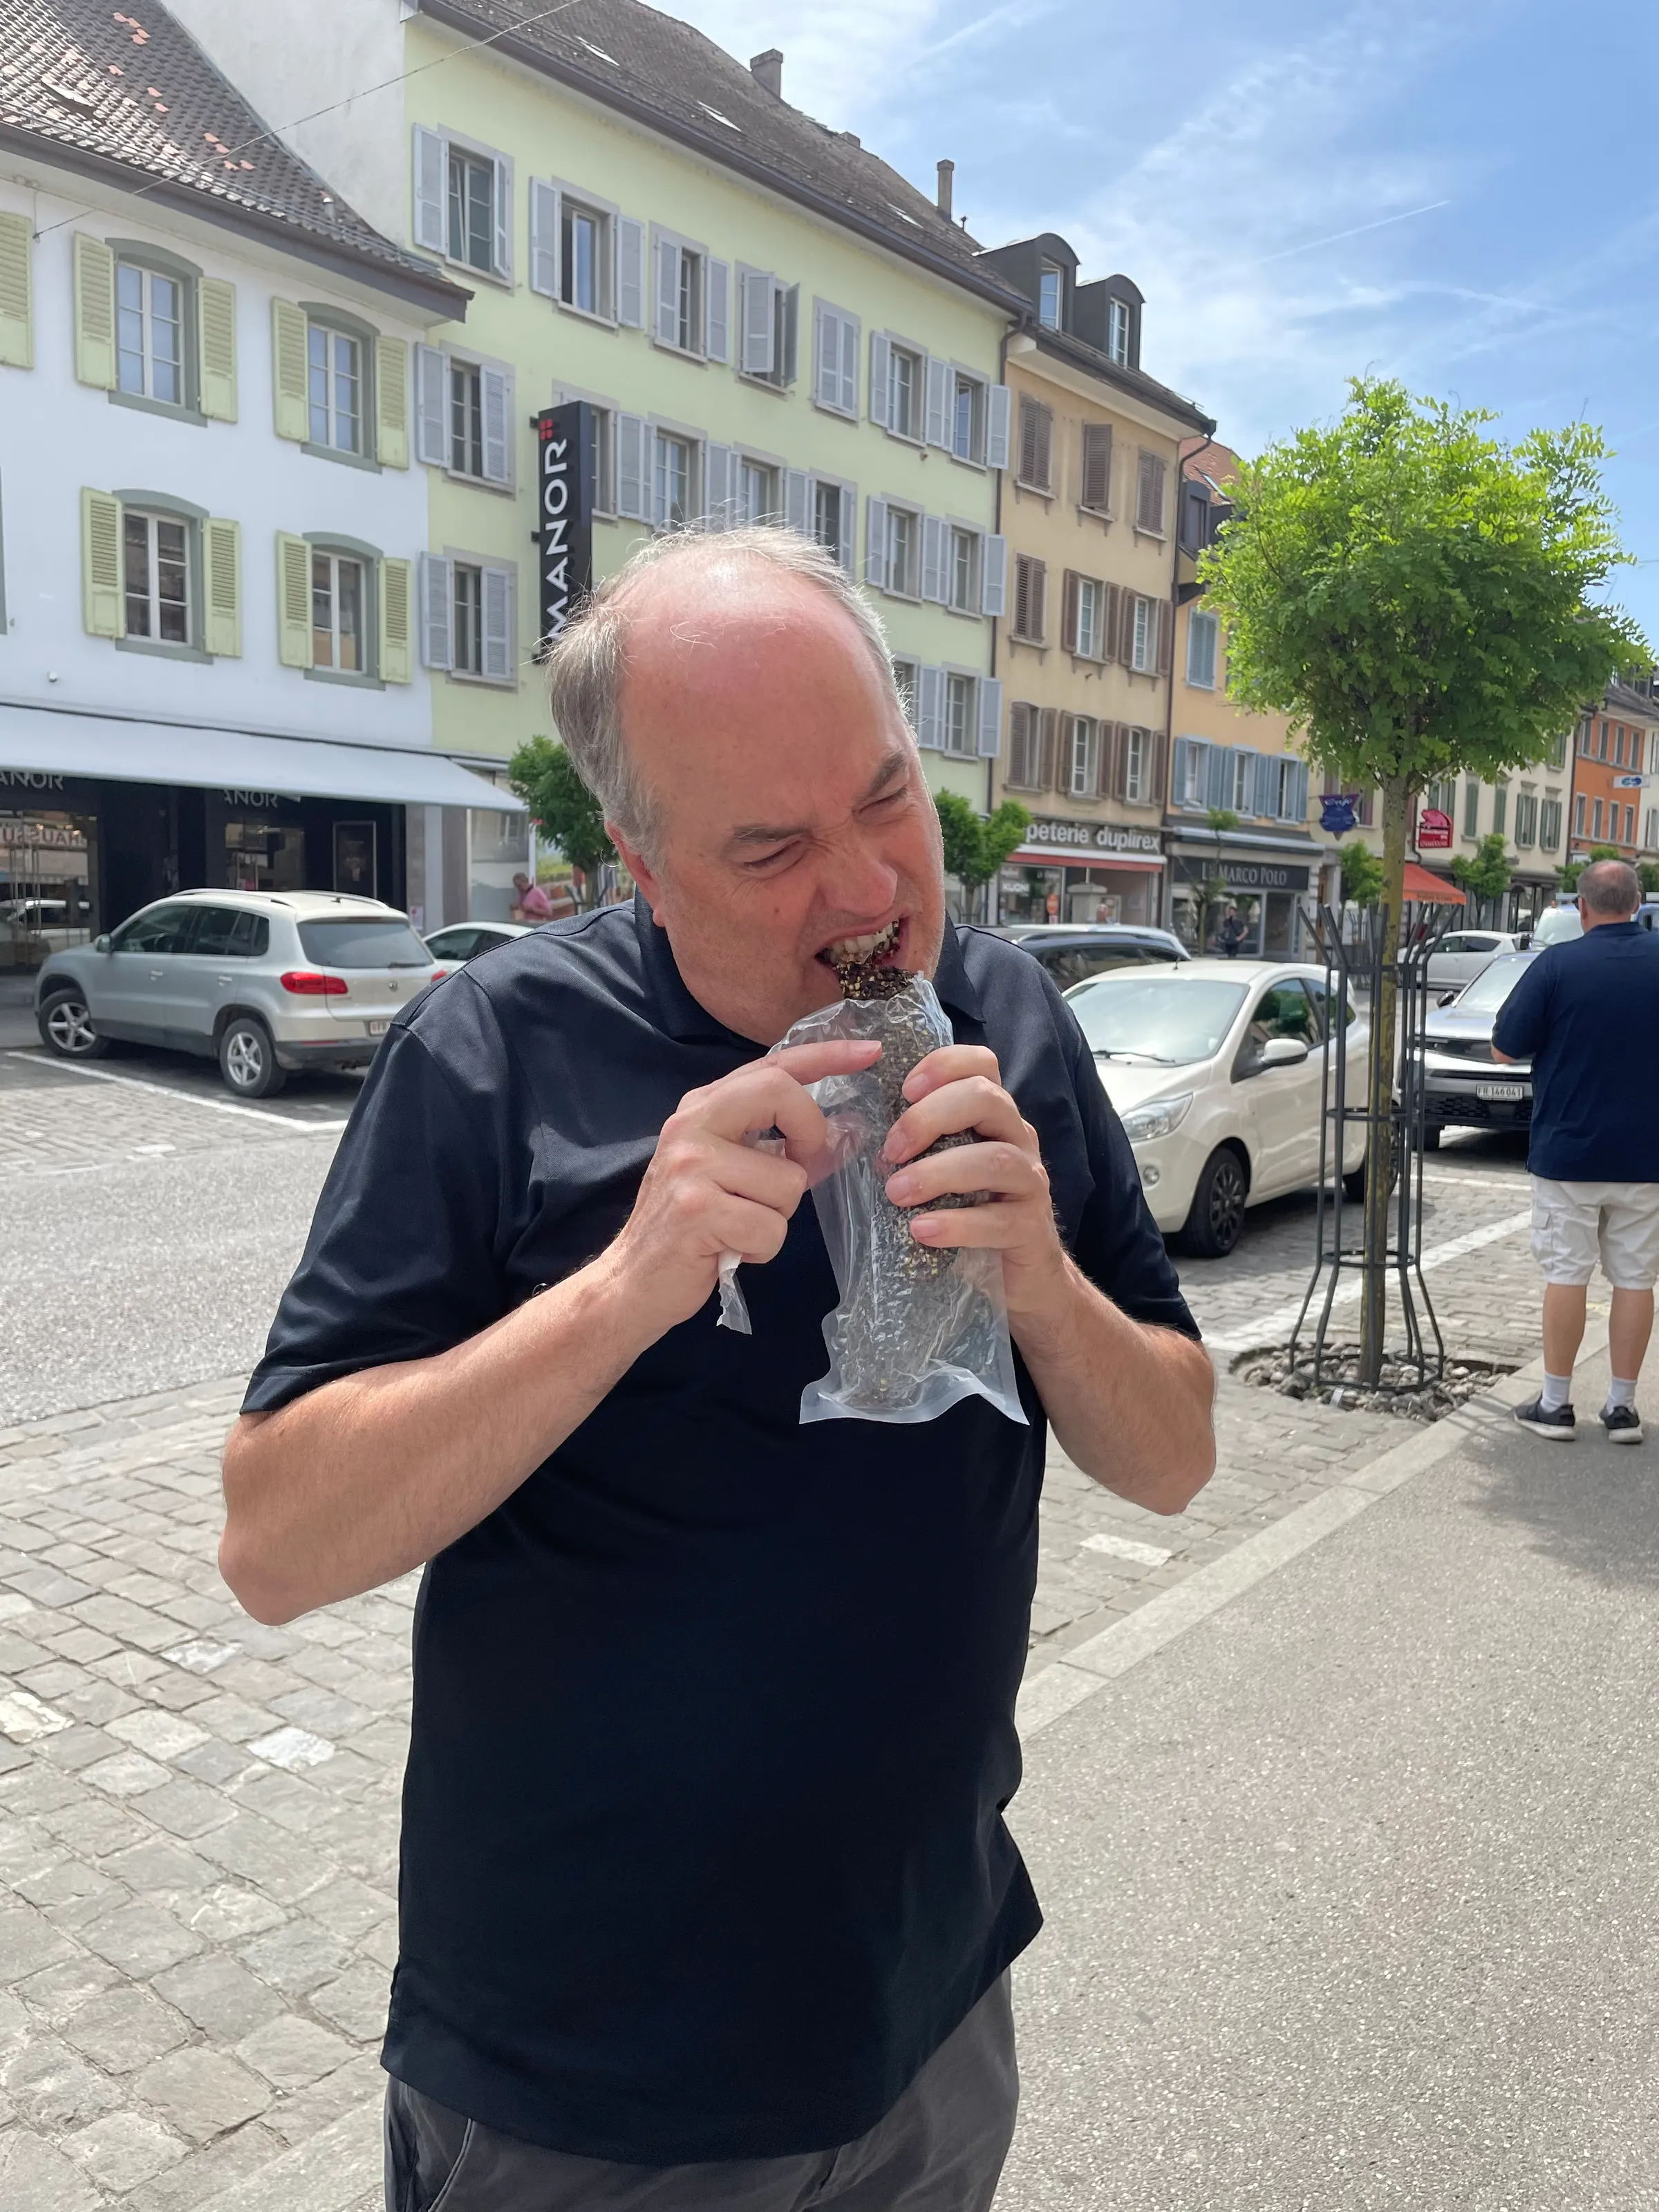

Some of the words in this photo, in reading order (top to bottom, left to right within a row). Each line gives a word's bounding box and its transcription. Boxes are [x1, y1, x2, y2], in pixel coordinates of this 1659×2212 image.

[545, 438, 569, 641] MANOR
[1025, 821, 1089, 844] peterie
[1096, 826, 1160, 854] duplirex
[1218, 864, 1257, 884] MARCO
[1260, 867, 1287, 886] POLO
